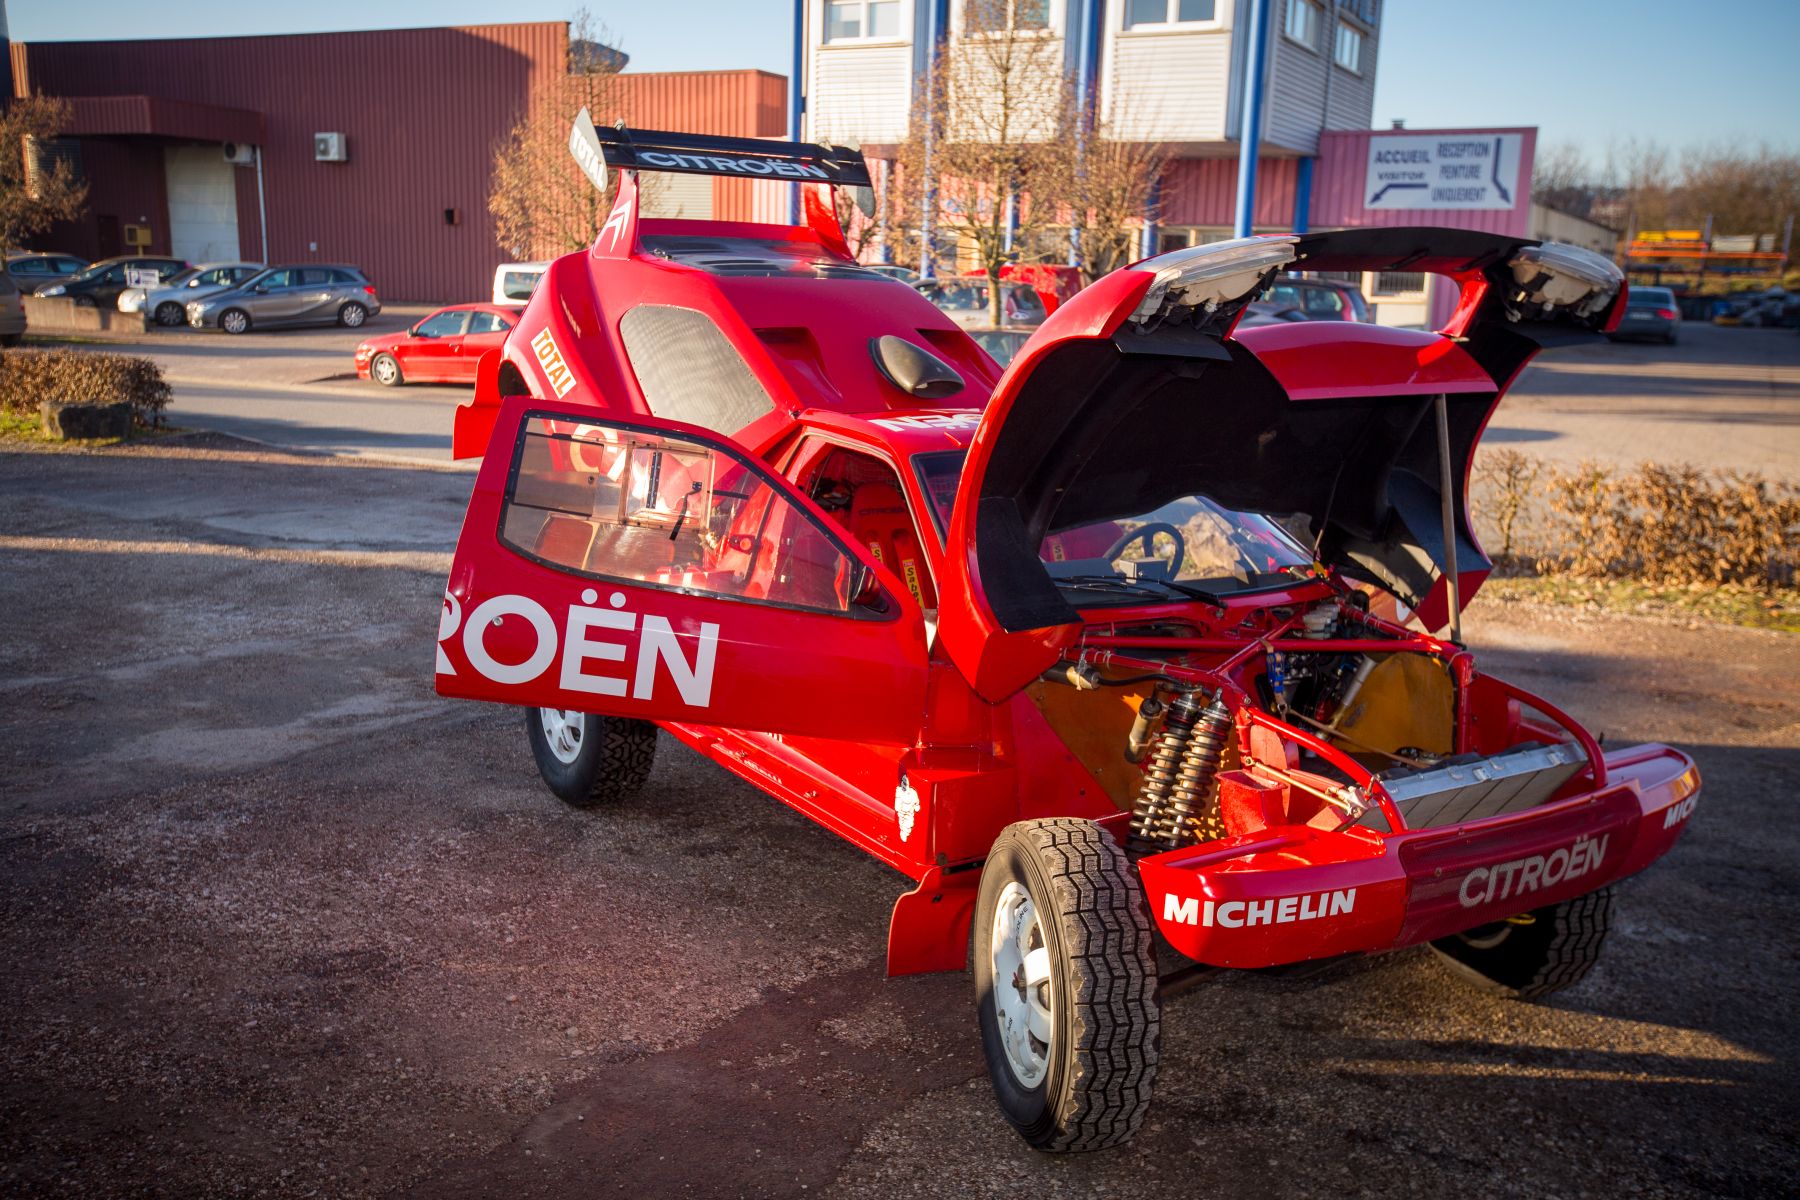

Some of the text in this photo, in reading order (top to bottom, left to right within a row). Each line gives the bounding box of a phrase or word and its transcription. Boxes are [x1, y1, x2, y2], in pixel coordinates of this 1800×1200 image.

[573, 126, 604, 188] TOTAL
[640, 151, 830, 179] CITROËN
[1374, 150, 1432, 164] ACCUEIL
[534, 331, 571, 395] TOTAL
[1458, 832, 1608, 908] CITROËN
[1163, 887, 1357, 929] MICHELIN
